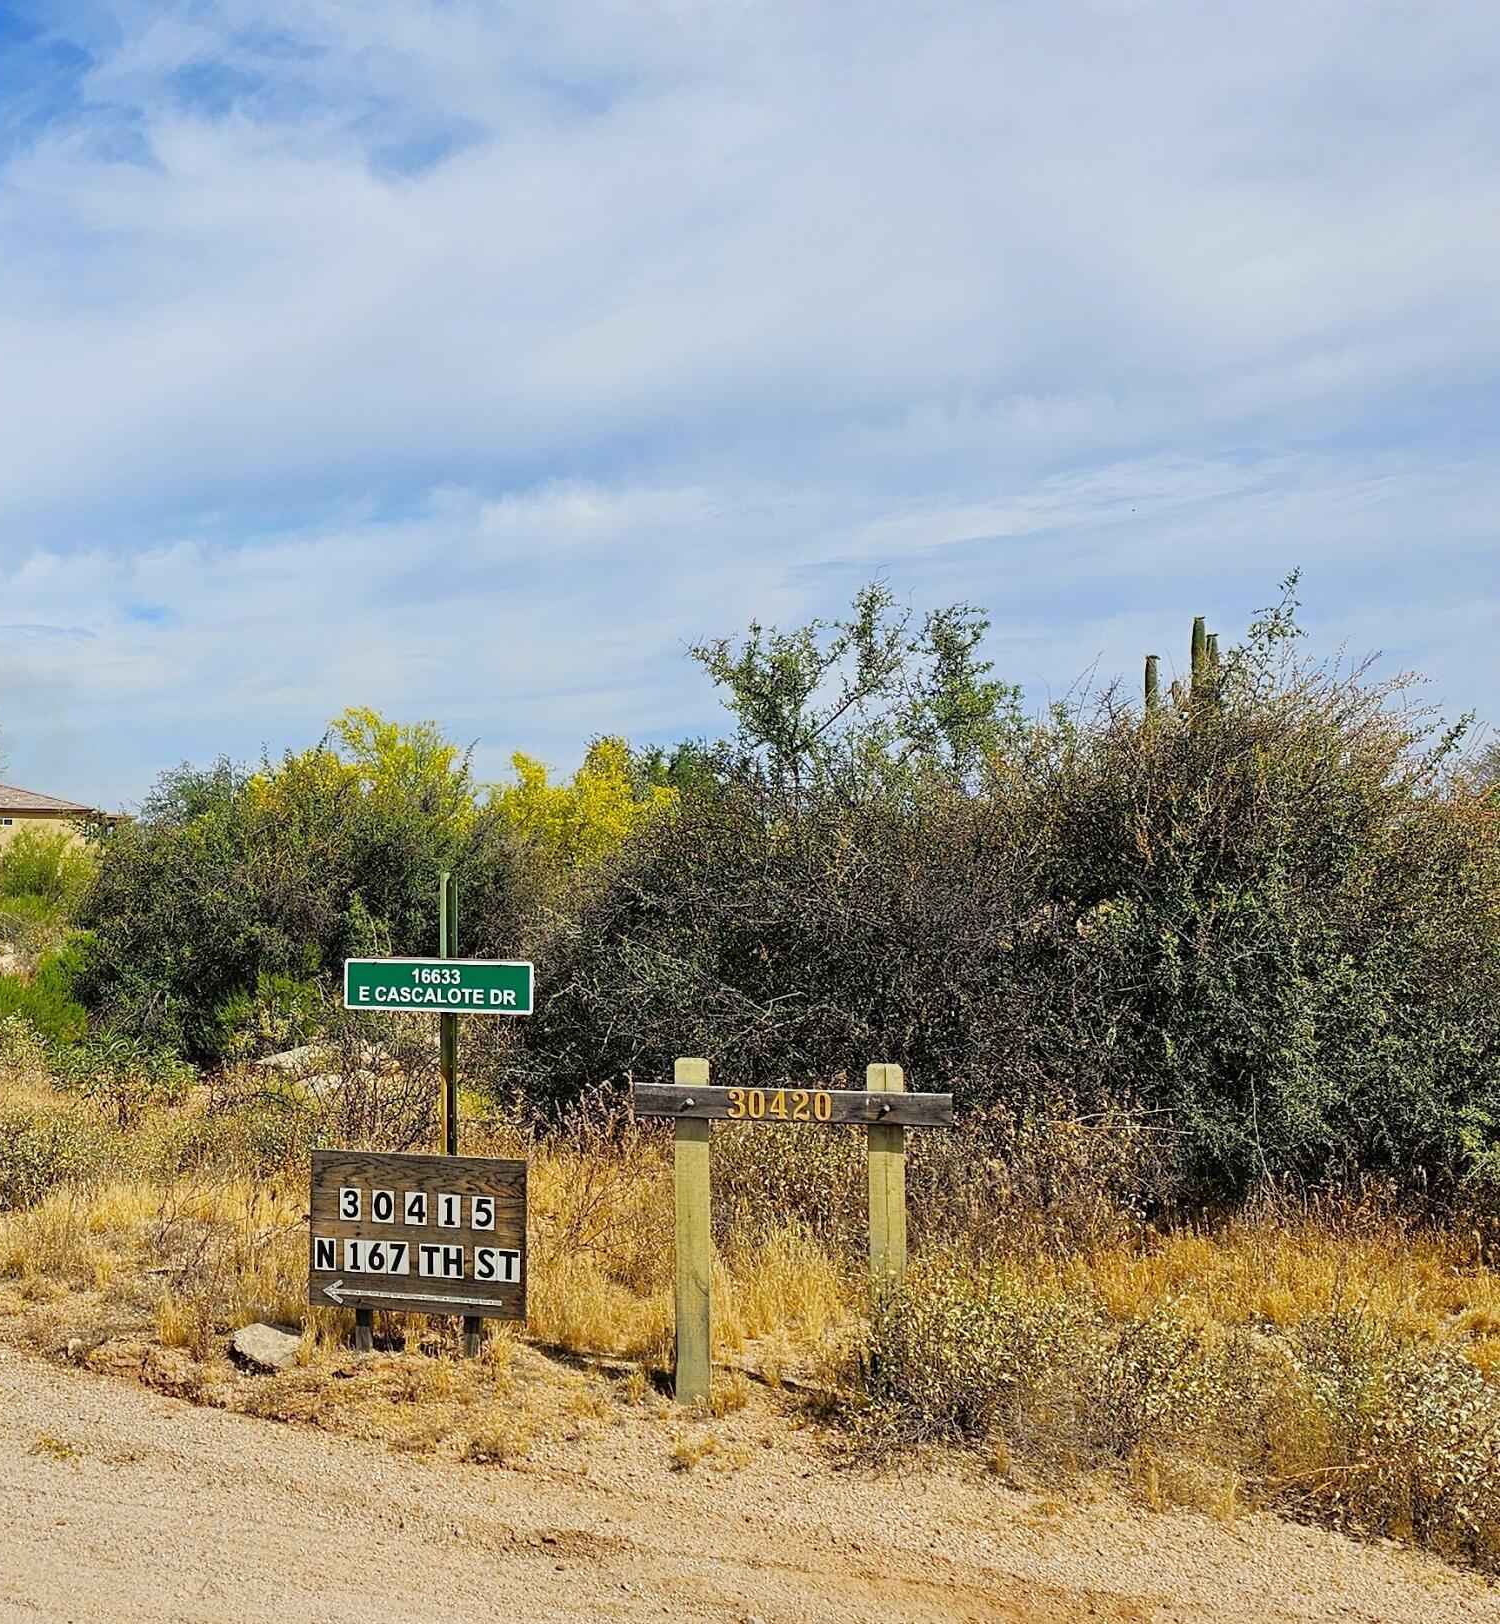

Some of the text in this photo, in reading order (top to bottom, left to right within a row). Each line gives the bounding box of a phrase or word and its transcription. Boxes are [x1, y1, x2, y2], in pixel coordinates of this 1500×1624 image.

[411, 968, 461, 985] 16633
[358, 985, 516, 1006] E CASCALOTE DR
[726, 1087, 833, 1122] 30420
[342, 1189, 492, 1227] 30415
[316, 1239, 519, 1280] N 167 TH ST
